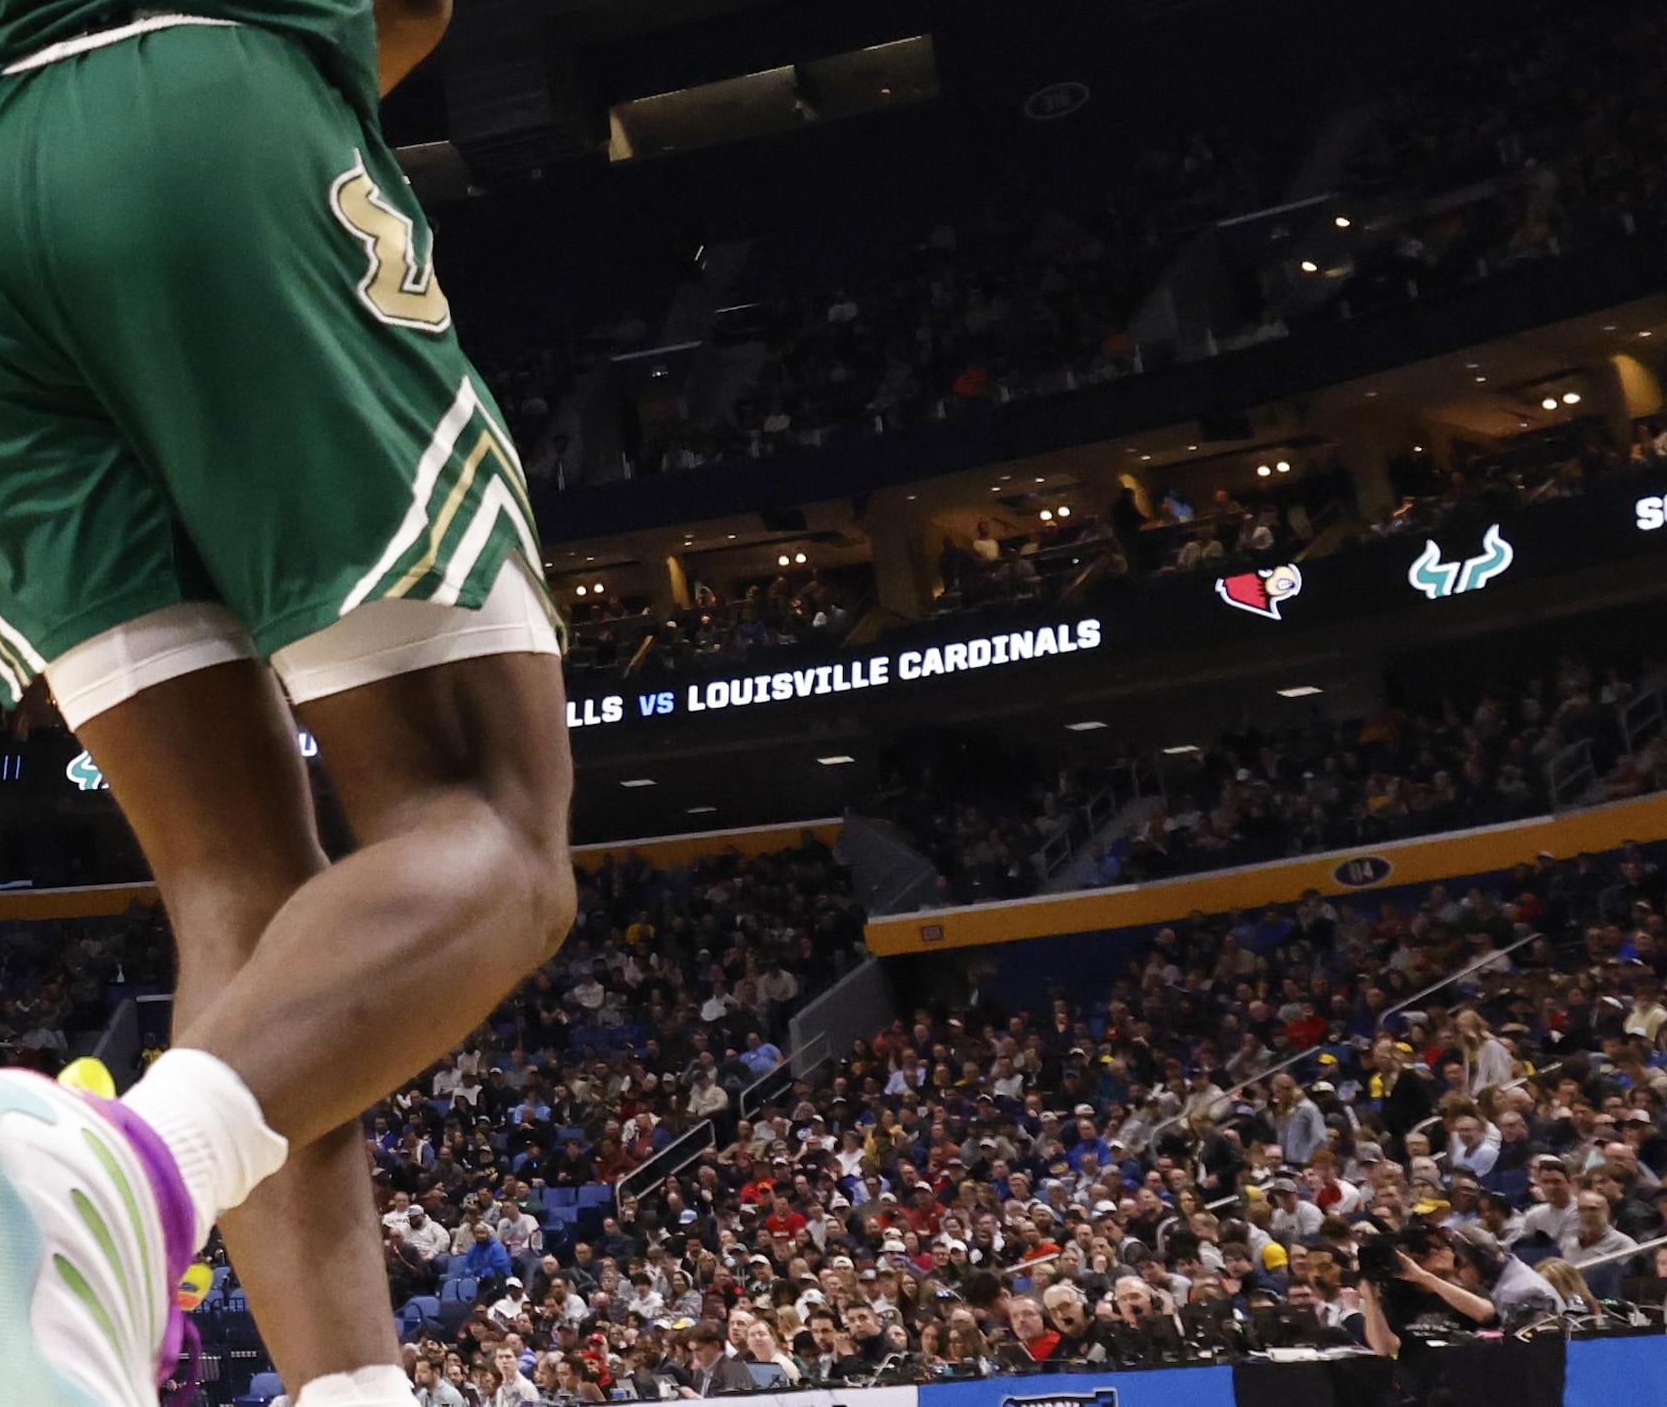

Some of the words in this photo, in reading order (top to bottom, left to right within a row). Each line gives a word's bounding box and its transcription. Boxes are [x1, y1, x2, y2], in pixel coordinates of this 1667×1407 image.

[639, 692, 675, 717] VS
[687, 657, 890, 713] LOUISVILLE
[899, 619, 1102, 680] CARDINALS
